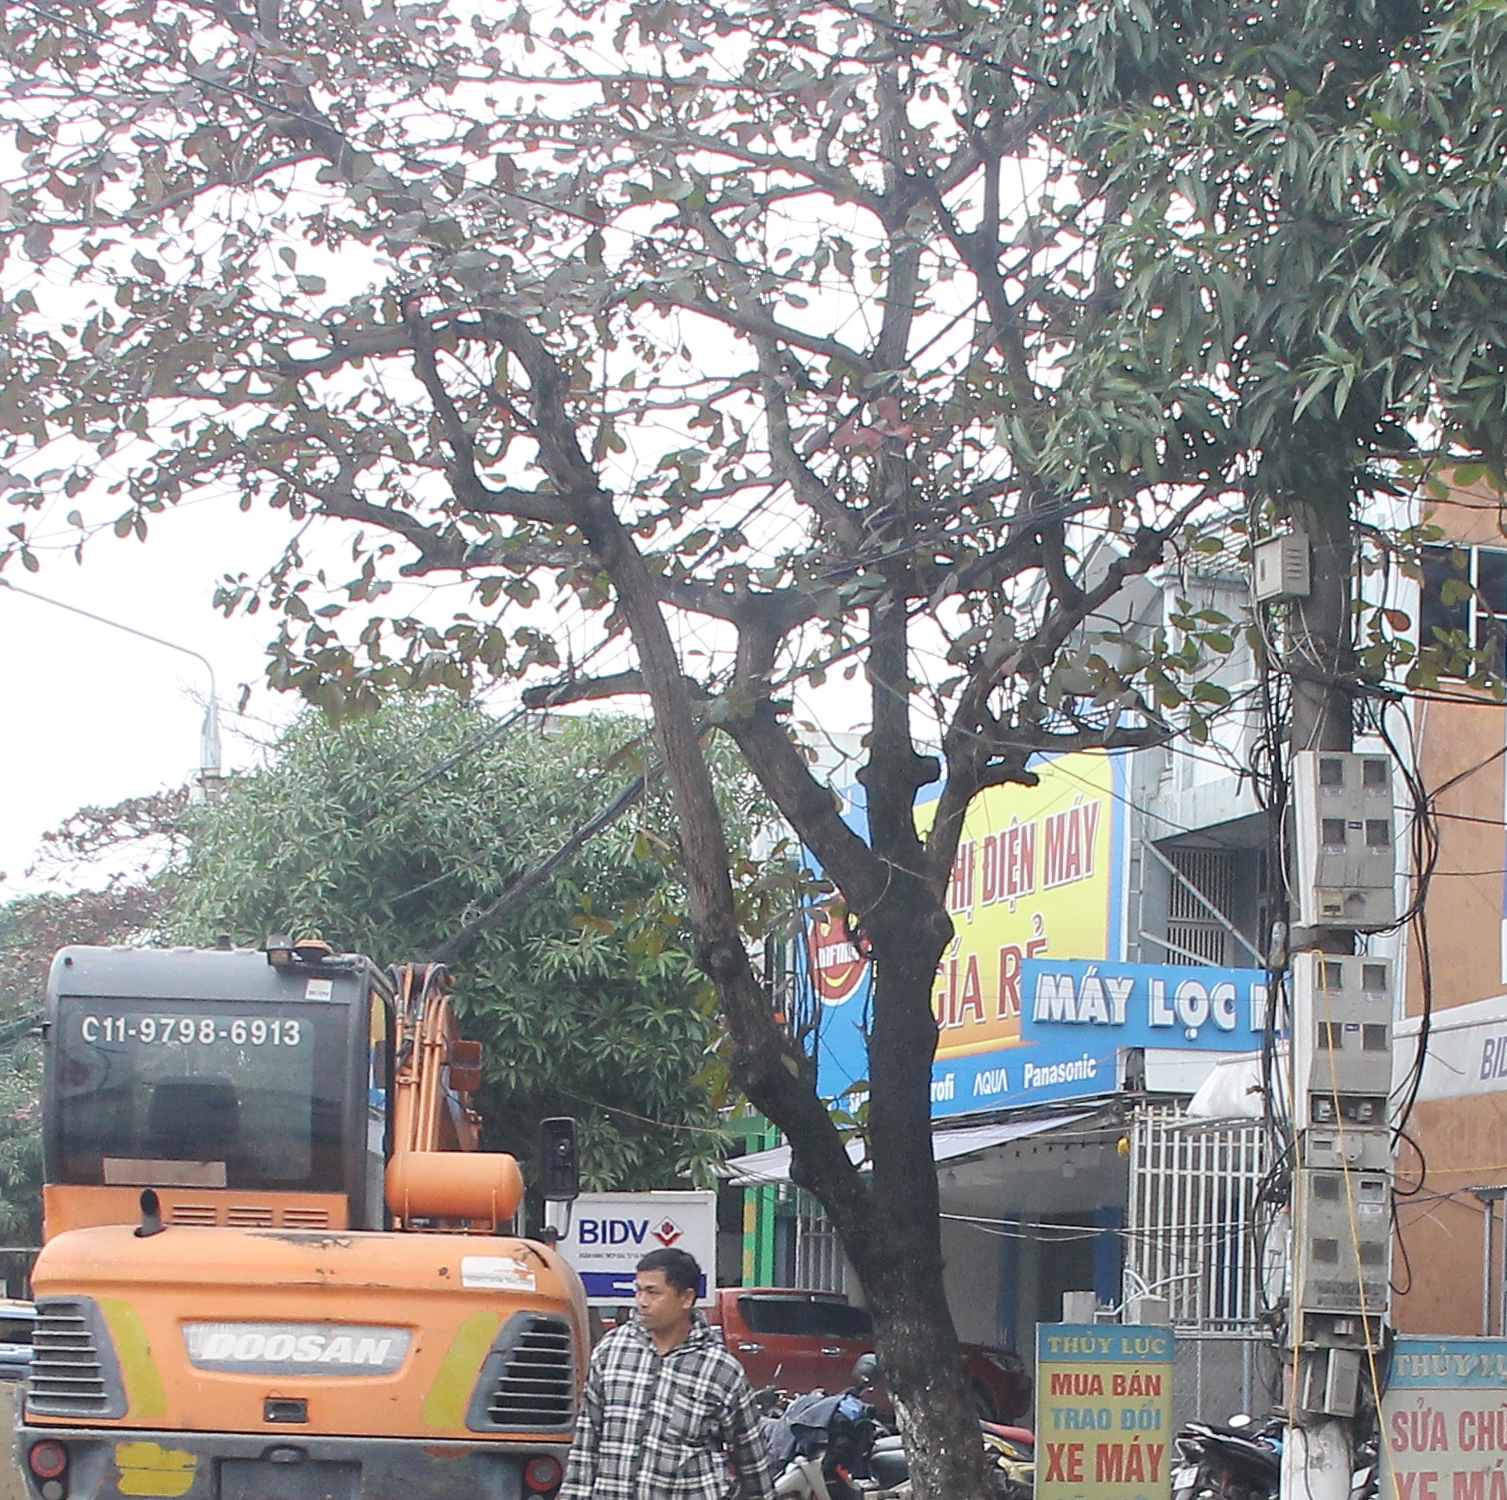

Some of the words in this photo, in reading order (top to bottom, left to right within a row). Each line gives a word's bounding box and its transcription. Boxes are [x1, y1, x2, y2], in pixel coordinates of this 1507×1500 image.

[950, 840, 976, 924] HỊ
[982, 815, 1038, 912] ĐIỆN
[1043, 794, 1101, 890] MÁY
[1033, 965, 1135, 1027] MÁY
[1147, 978, 1237, 1042] LỌC
[81, 1016, 302, 1046] C11-9798-6913
[973, 1068, 1009, 1098] AQUA
[1023, 1053, 1099, 1090] Panasonic
[578, 1220, 649, 1245] BIDV
[201, 1333, 392, 1365] DOOSAN
[1047, 1330, 1113, 1355] THỦY
[1121, 1333, 1168, 1358] LỰC
[1393, 1346, 1471, 1377] THỦY
[1051, 1373, 1105, 1396] MUA
[1112, 1369, 1162, 1397] BÁN
[1051, 1407, 1113, 1431] TRAO
[1392, 1396, 1449, 1452] SỬA
[1045, 1442, 1085, 1483] XE
[1096, 1434, 1166, 1483] MÁY
